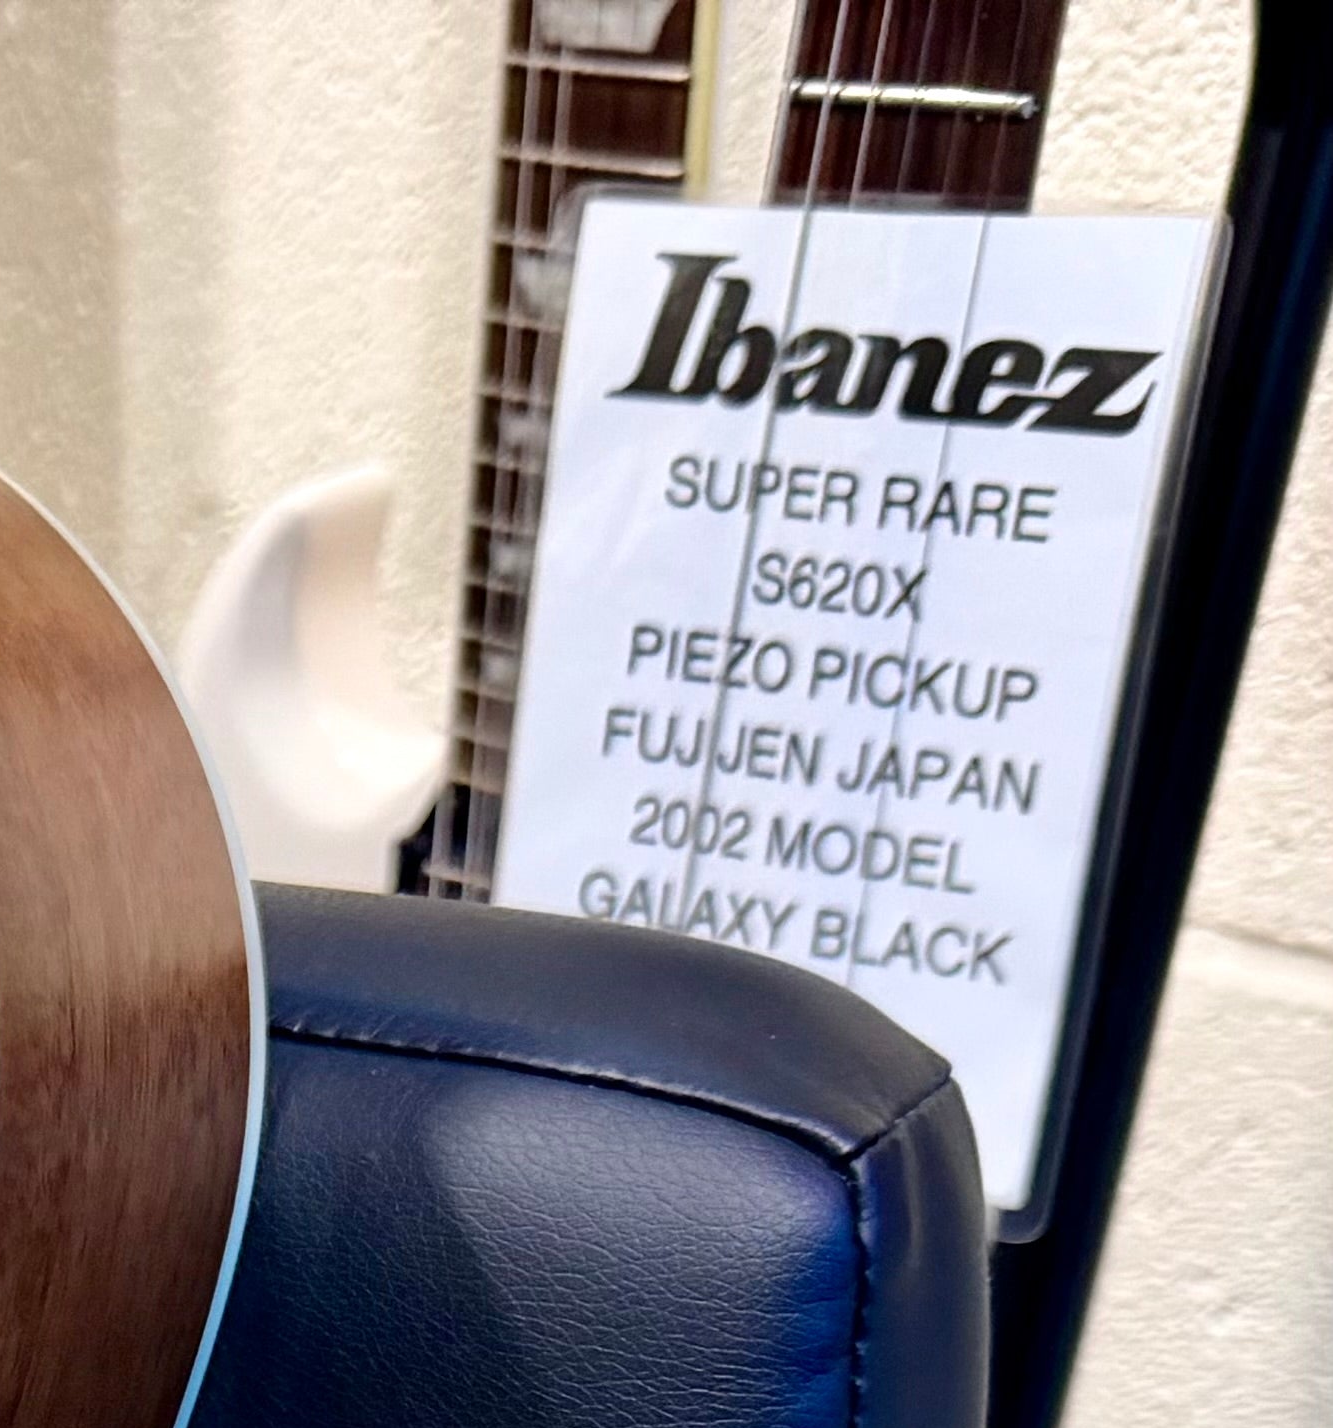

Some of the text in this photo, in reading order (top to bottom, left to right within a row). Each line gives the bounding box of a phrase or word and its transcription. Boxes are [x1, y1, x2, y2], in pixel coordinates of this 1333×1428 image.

[605, 251, 1163, 438] Ibanez
[665, 455, 1058, 544] SUPER RARE
[751, 553, 930, 622] S620X
[626, 625, 1039, 723] PIEZO PICKUP
[837, 741, 1041, 816] JAPAN
[630, 796, 976, 895] 2002 MODEL
[578, 870, 1014, 986] GALAXY BLACK
